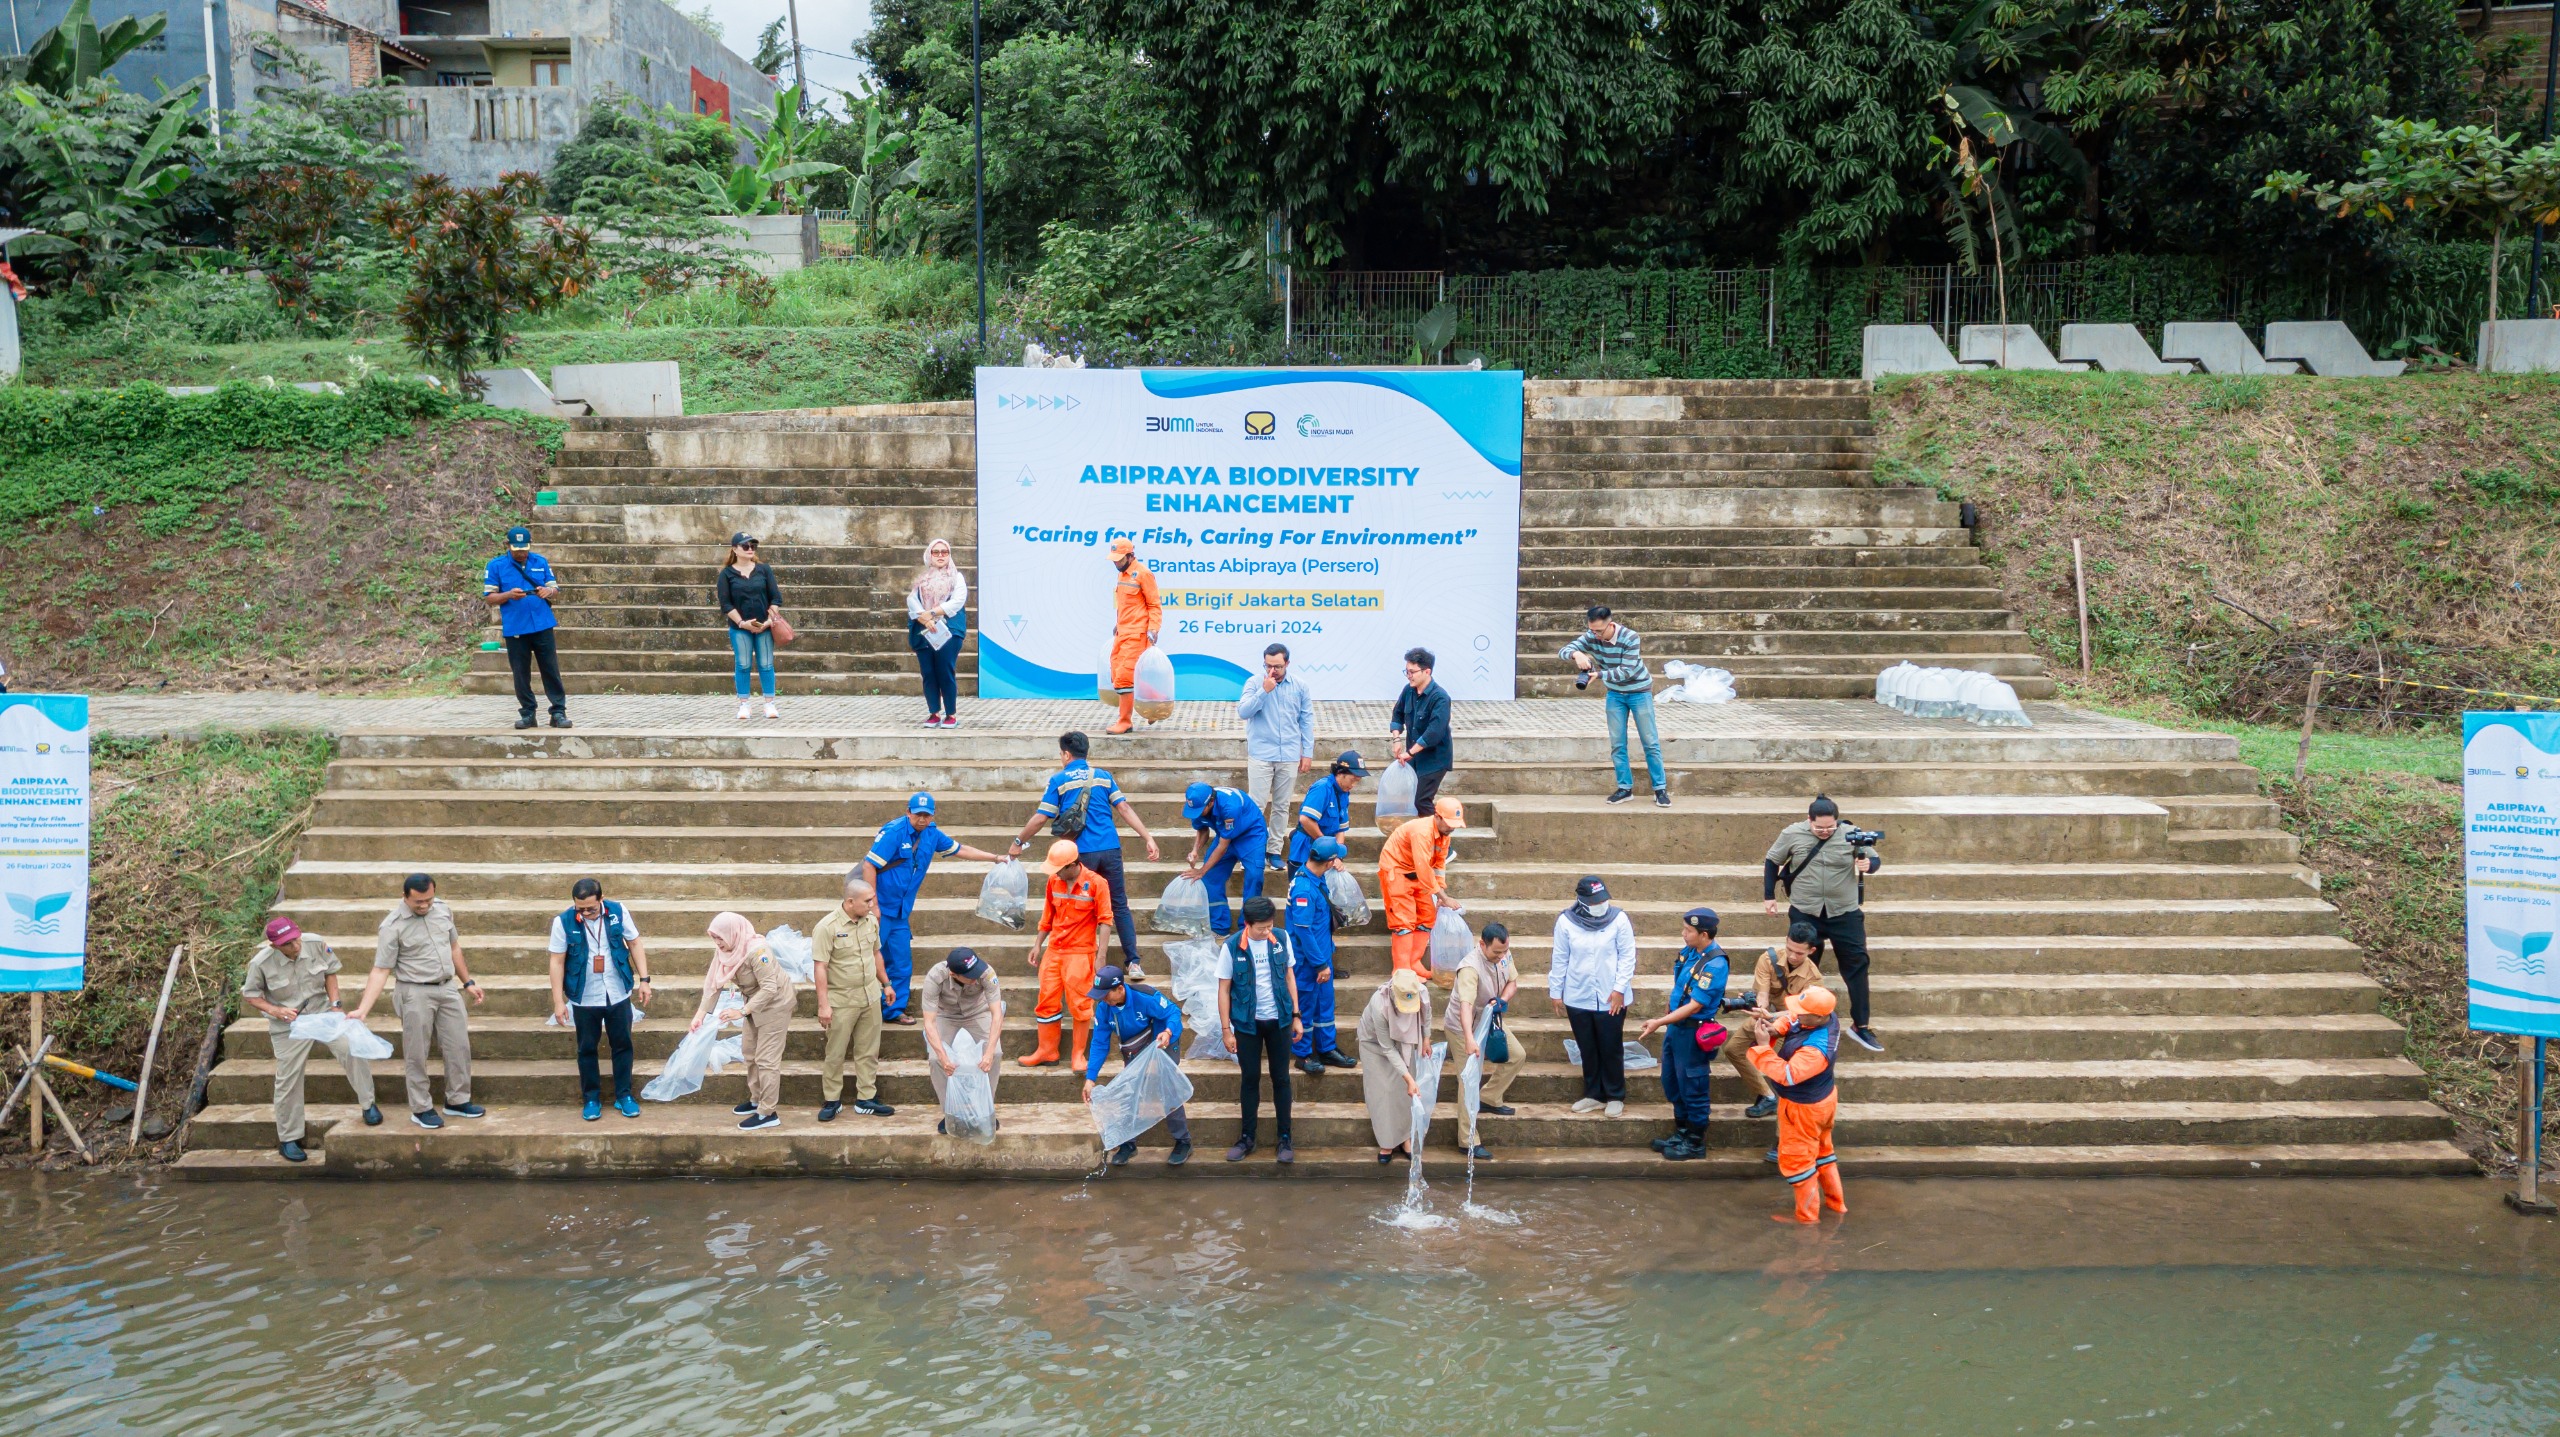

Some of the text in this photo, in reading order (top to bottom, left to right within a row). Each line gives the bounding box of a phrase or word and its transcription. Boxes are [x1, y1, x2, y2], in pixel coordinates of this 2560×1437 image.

[1079, 465, 1420, 486] ABIPRAYA BIODIVERSITY
[1146, 493, 1354, 513] ENHANCEMENT
[1142, 526, 1192, 547] Fish,
[1200, 528, 1273, 548] Caring
[1280, 530, 1316, 545] For
[1148, 558, 1378, 576] Brantas Abipraya (Persero)
[1186, 592, 1233, 610] Brigif
[1239, 593, 1306, 607] Jakarta
[1311, 593, 1378, 607] Selatan
[1179, 620, 1322, 634] 26 Februari 2024
[0, 798, 82, 806] ENHANCEMENT
[2487, 803, 2546, 813] ABIPRAYA
[2476, 814, 2558, 826] BIODIVERSITY
[2472, 824, 2560, 836] ENHANCEMENT
[2470, 850, 2496, 858] Caring
[2532, 898, 2551, 906] 2024
